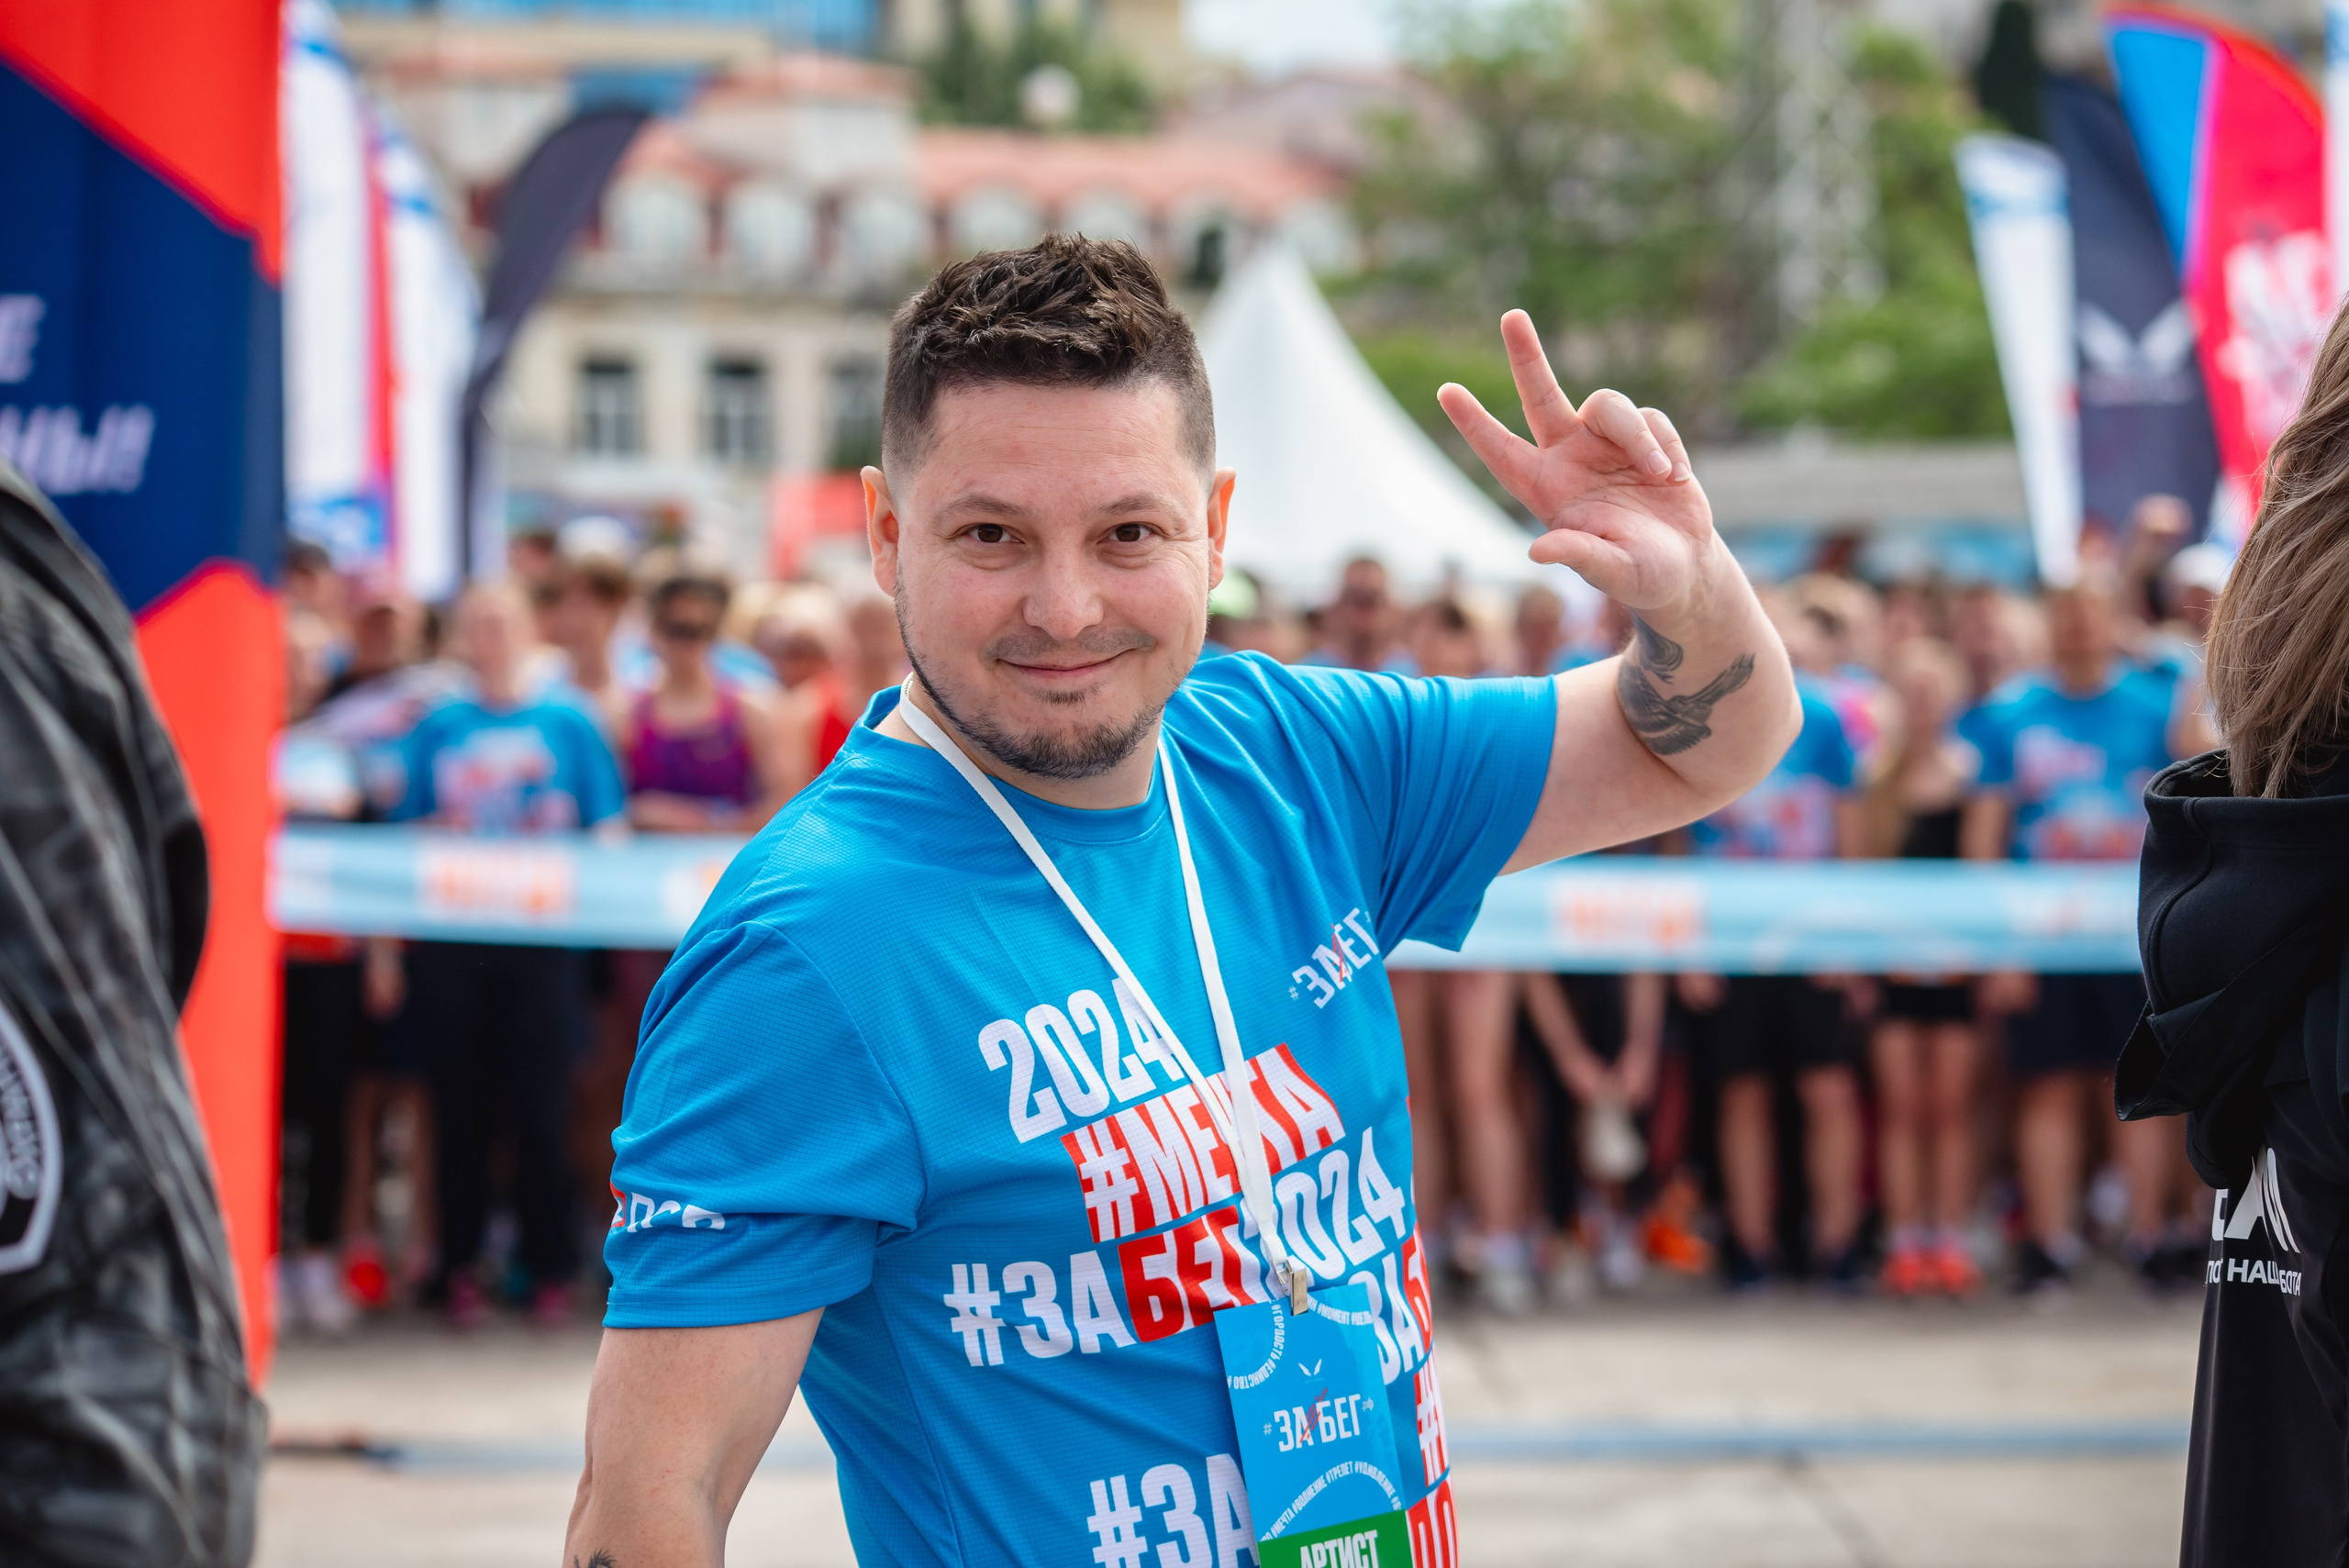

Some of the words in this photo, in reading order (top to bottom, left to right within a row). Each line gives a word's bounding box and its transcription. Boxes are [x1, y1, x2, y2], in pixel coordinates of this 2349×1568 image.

[977, 978, 1185, 1143] 2024
[942, 1209, 1275, 1367] #ЗАБЕГ
[1271, 1303, 1286, 1361] #ГОРДОСТЬ
[1233, 1358, 1276, 1390] #ЕДИНСТВО
[1270, 1507, 1296, 1538] #МЕЧТА
[1291, 1474, 1328, 1515] #ВОЛНЕНИЕ
[1325, 1461, 1353, 1484] #ТРЕПЕТ
[1300, 1529, 1378, 1568] АРТИСТ
